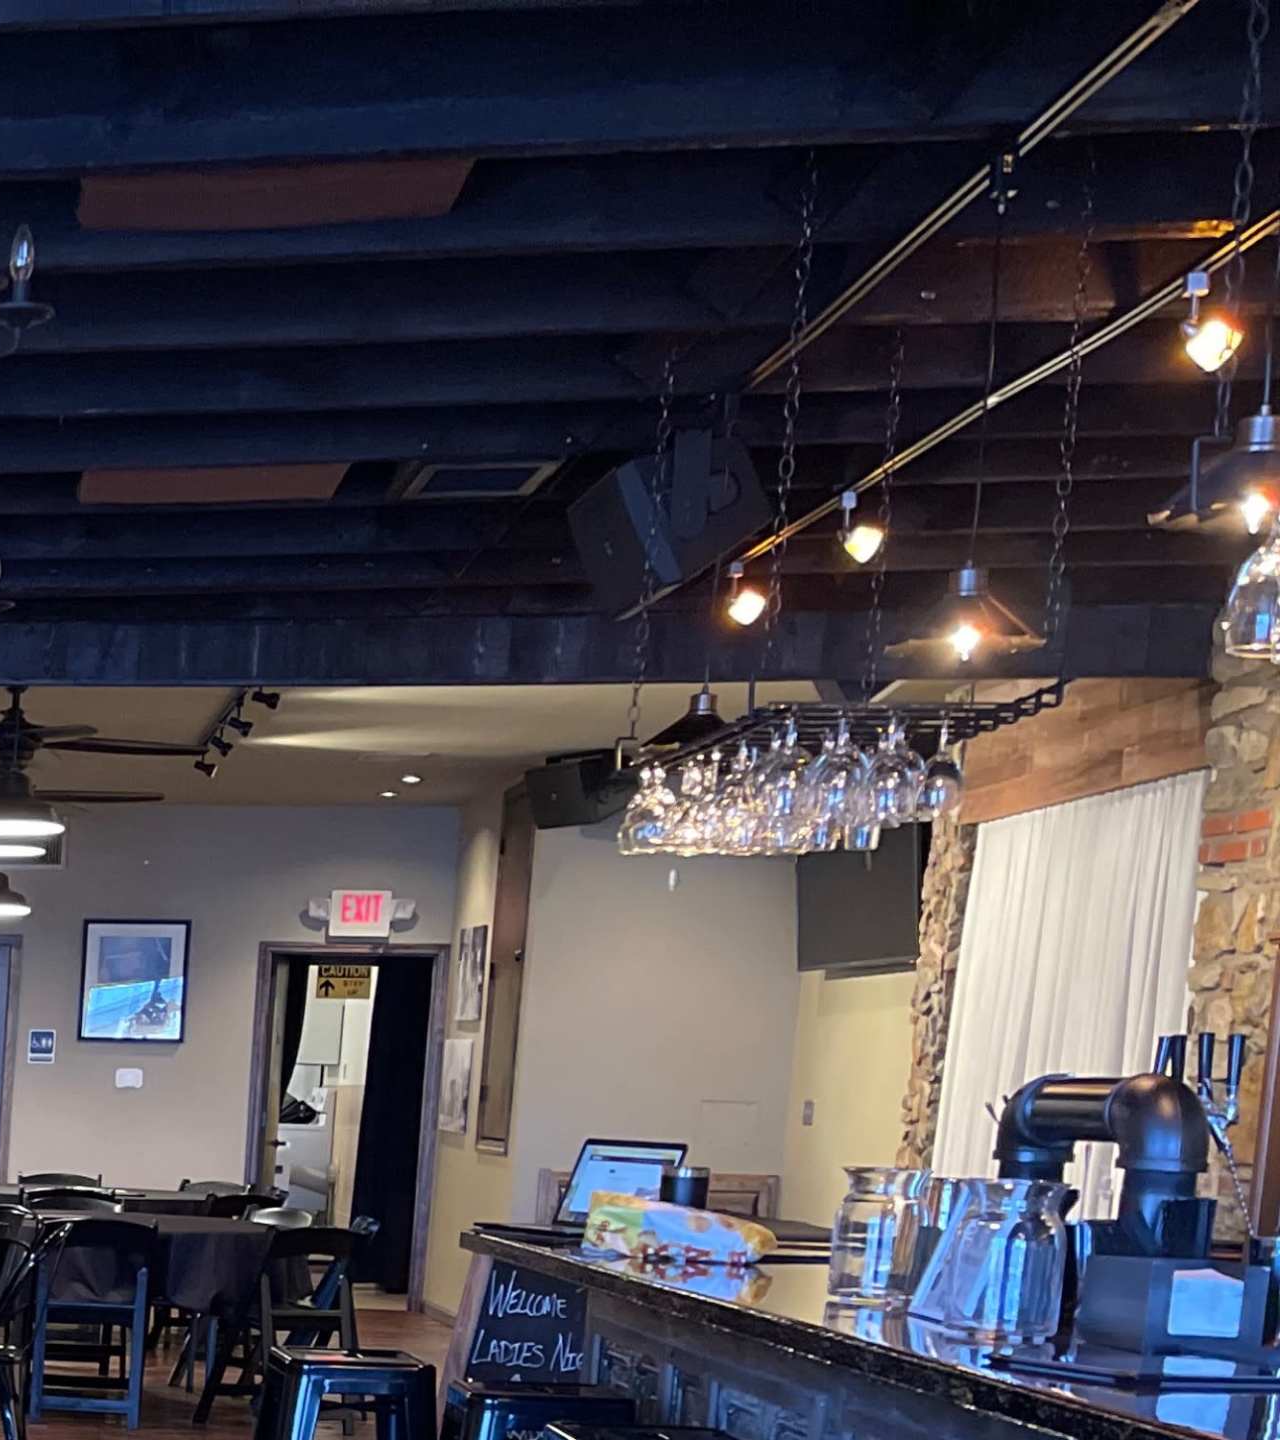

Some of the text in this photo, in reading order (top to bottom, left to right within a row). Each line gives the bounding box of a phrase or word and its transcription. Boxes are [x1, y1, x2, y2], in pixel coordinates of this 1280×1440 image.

[341, 893, 384, 923] EXIT
[321, 965, 369, 977] CAUTION
[488, 1269, 568, 1319] WELCOME
[471, 1328, 545, 1369] LADIES
